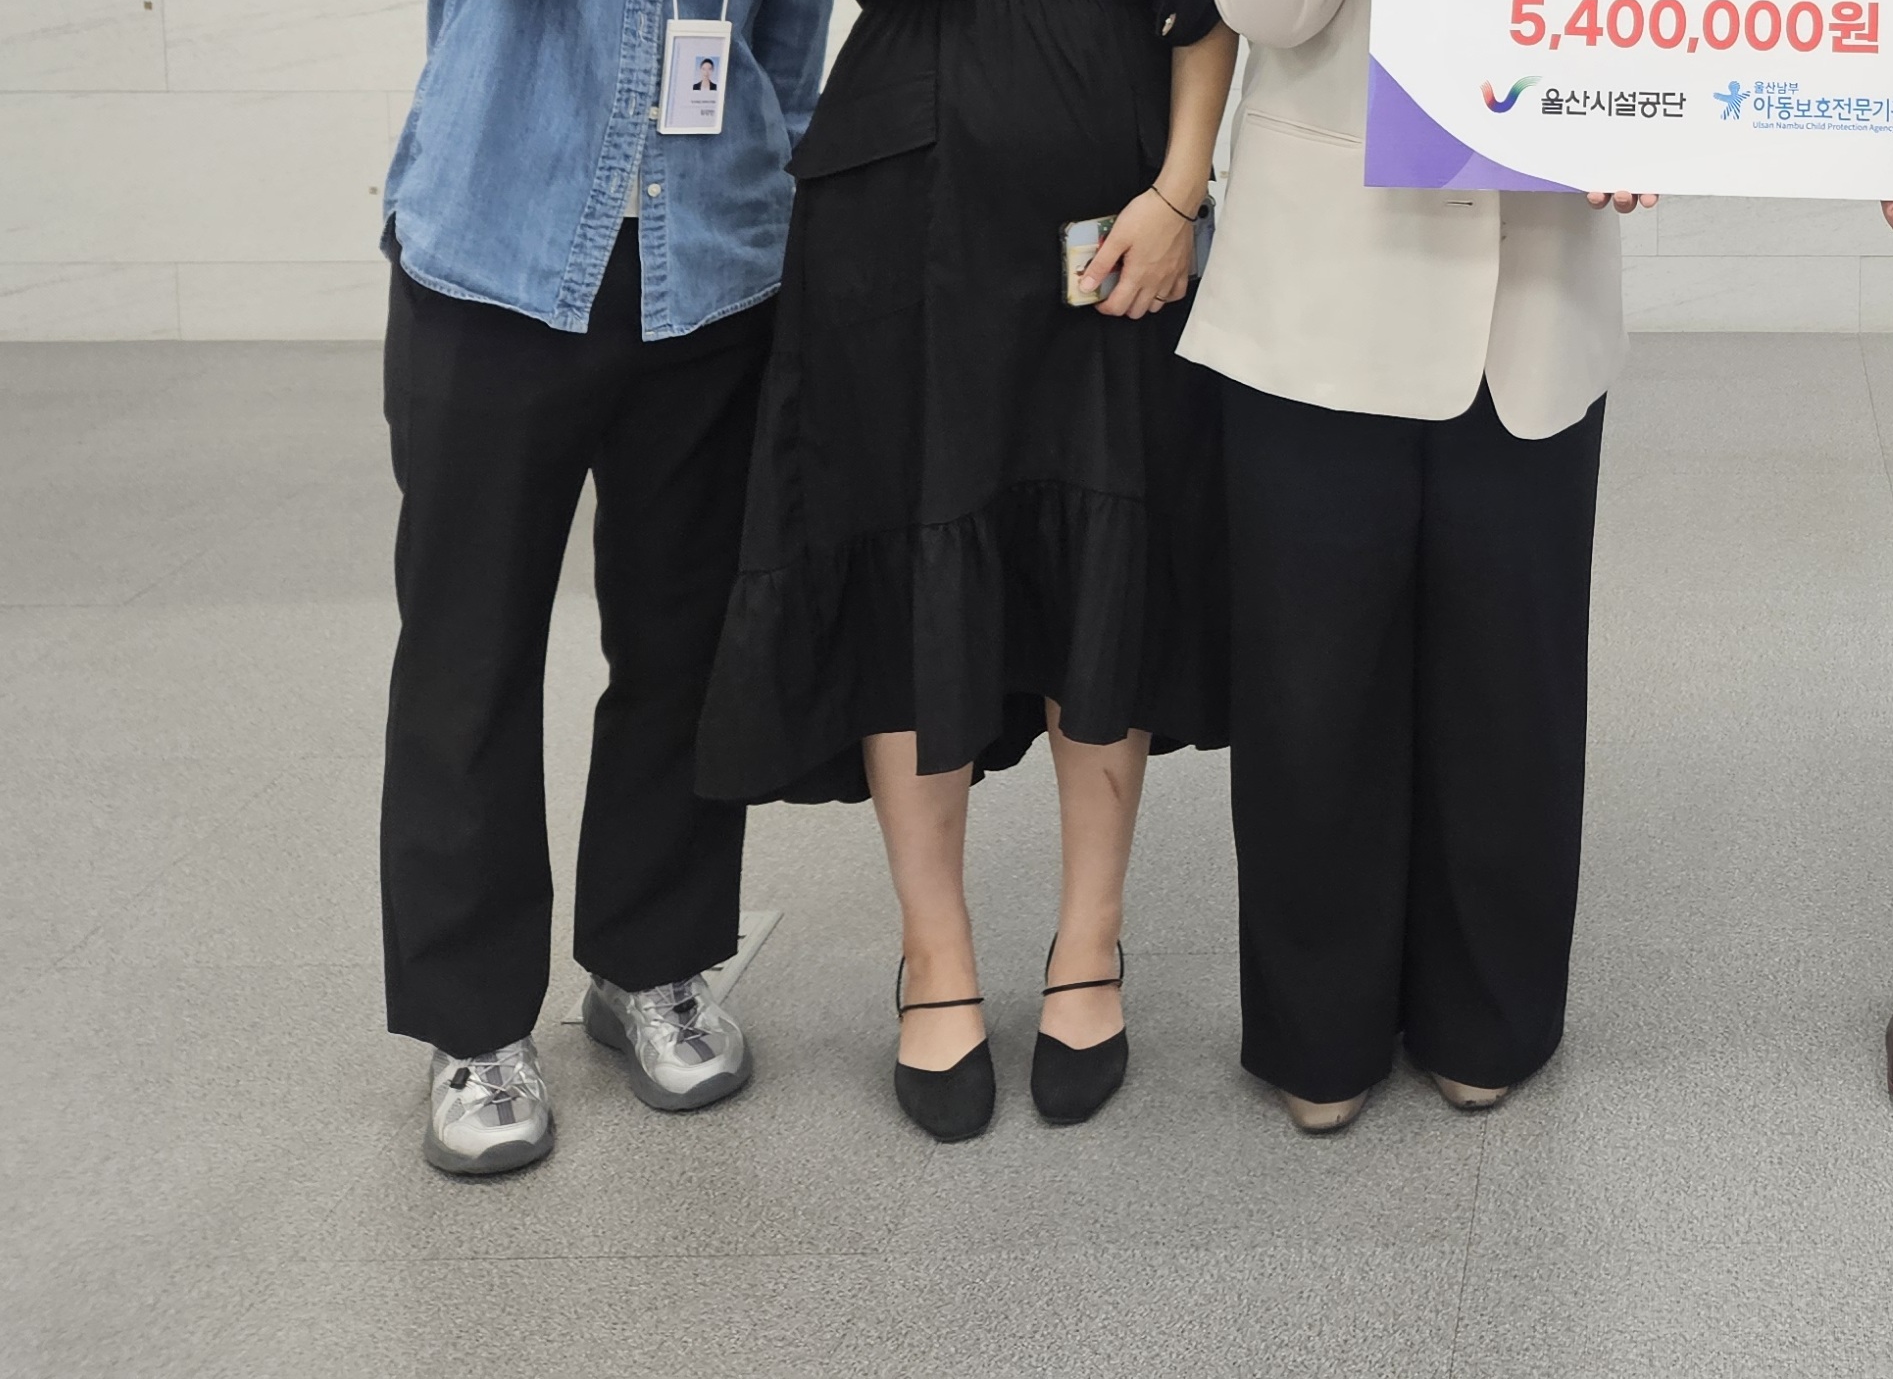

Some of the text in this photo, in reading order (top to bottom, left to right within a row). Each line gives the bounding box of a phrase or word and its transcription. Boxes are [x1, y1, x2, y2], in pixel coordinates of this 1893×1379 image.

[1753, 80, 1800, 95] 울산남부
[1540, 87, 1687, 118] 울산시설공단
[1752, 121, 1775, 129] Ulsan
[1776, 122, 1805, 130] Nambu
[1806, 122, 1826, 131] Child
[1827, 123, 1868, 132] Protection
